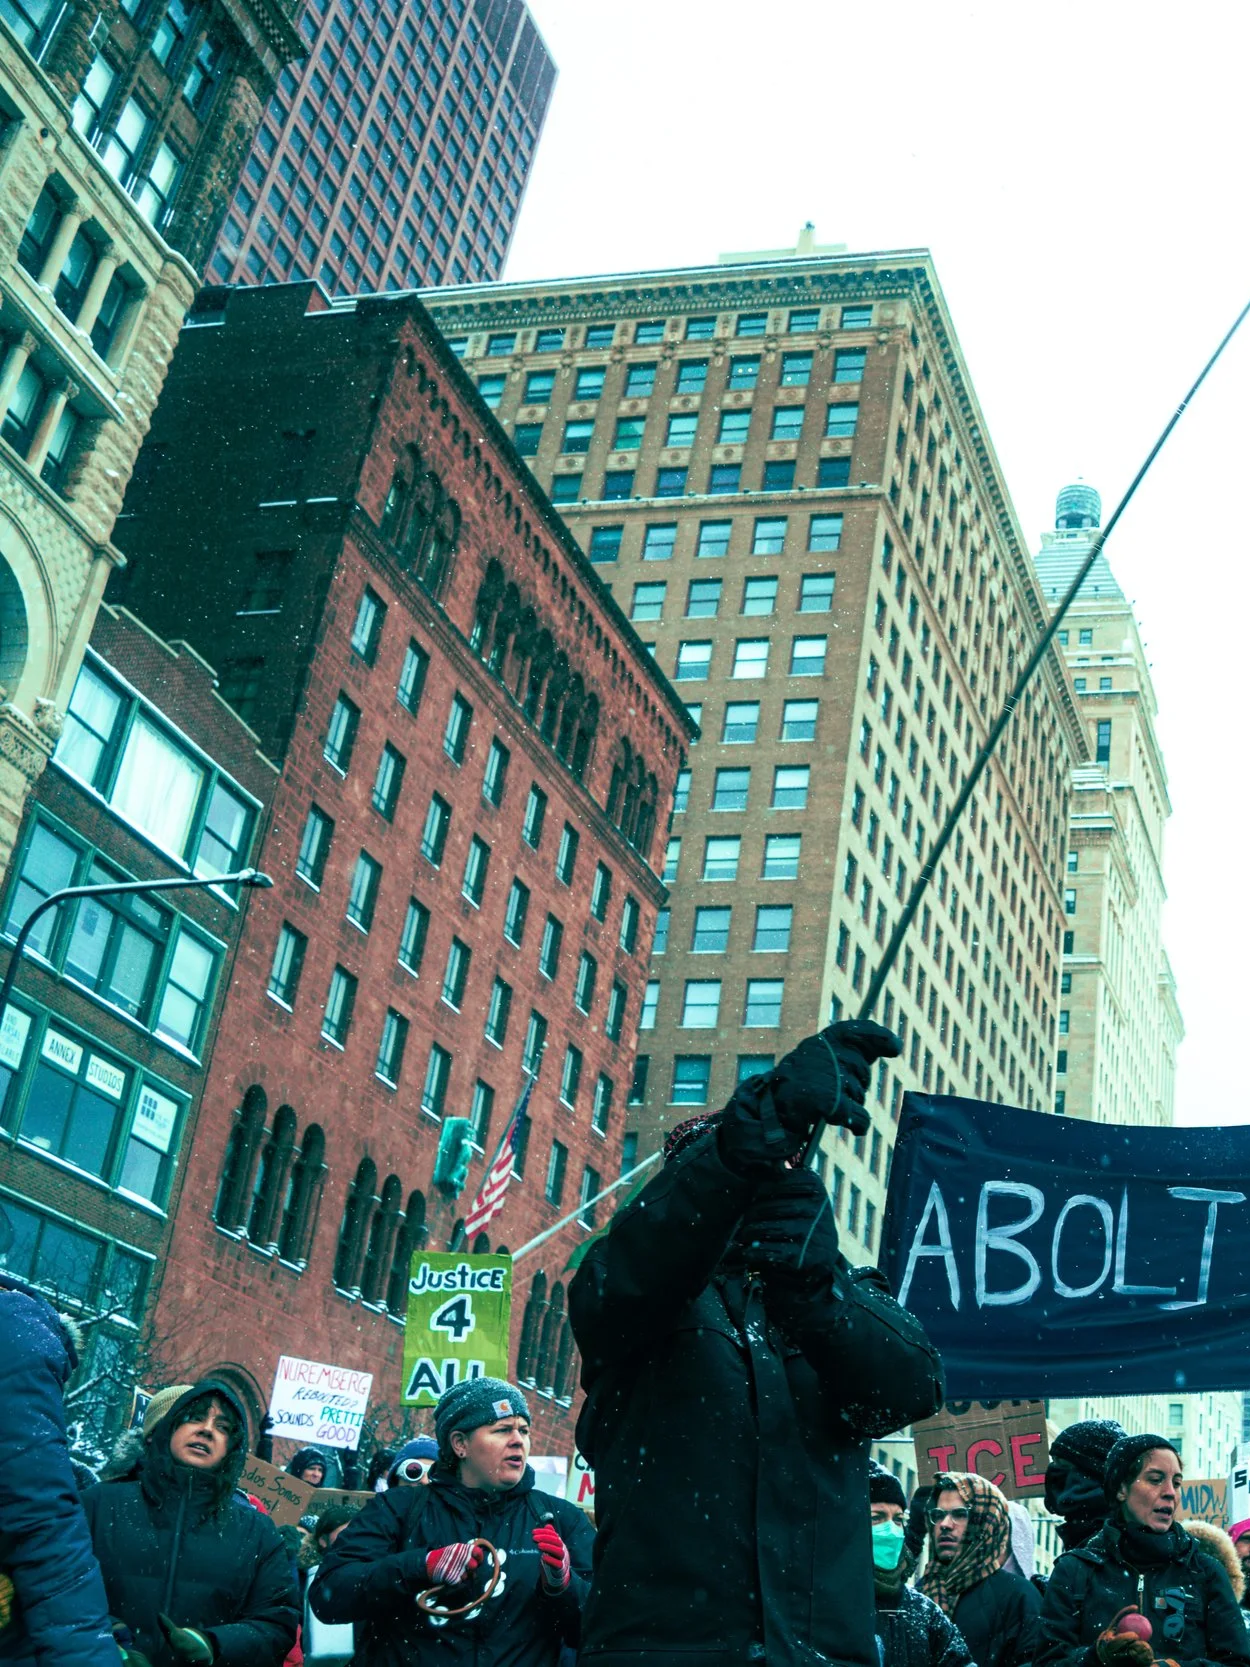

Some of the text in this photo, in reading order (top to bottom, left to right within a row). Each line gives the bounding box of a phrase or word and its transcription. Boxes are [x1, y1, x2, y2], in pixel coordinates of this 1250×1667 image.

[49, 1039, 123, 1093] ANNEX STUDIOS
[433, 1296, 473, 1340] 4
[279, 1359, 369, 1395] NUREMBERG
[292, 1387, 359, 1408] REBOOTED?
[275, 1406, 364, 1427] SOUNDS PRETTI
[316, 1424, 356, 1442] GOOD
[927, 1431, 1046, 1488] ICE
[241, 1467, 266, 1488] odos
[268, 1476, 302, 1506] Somos
[1181, 1484, 1227, 1514] MIDW
